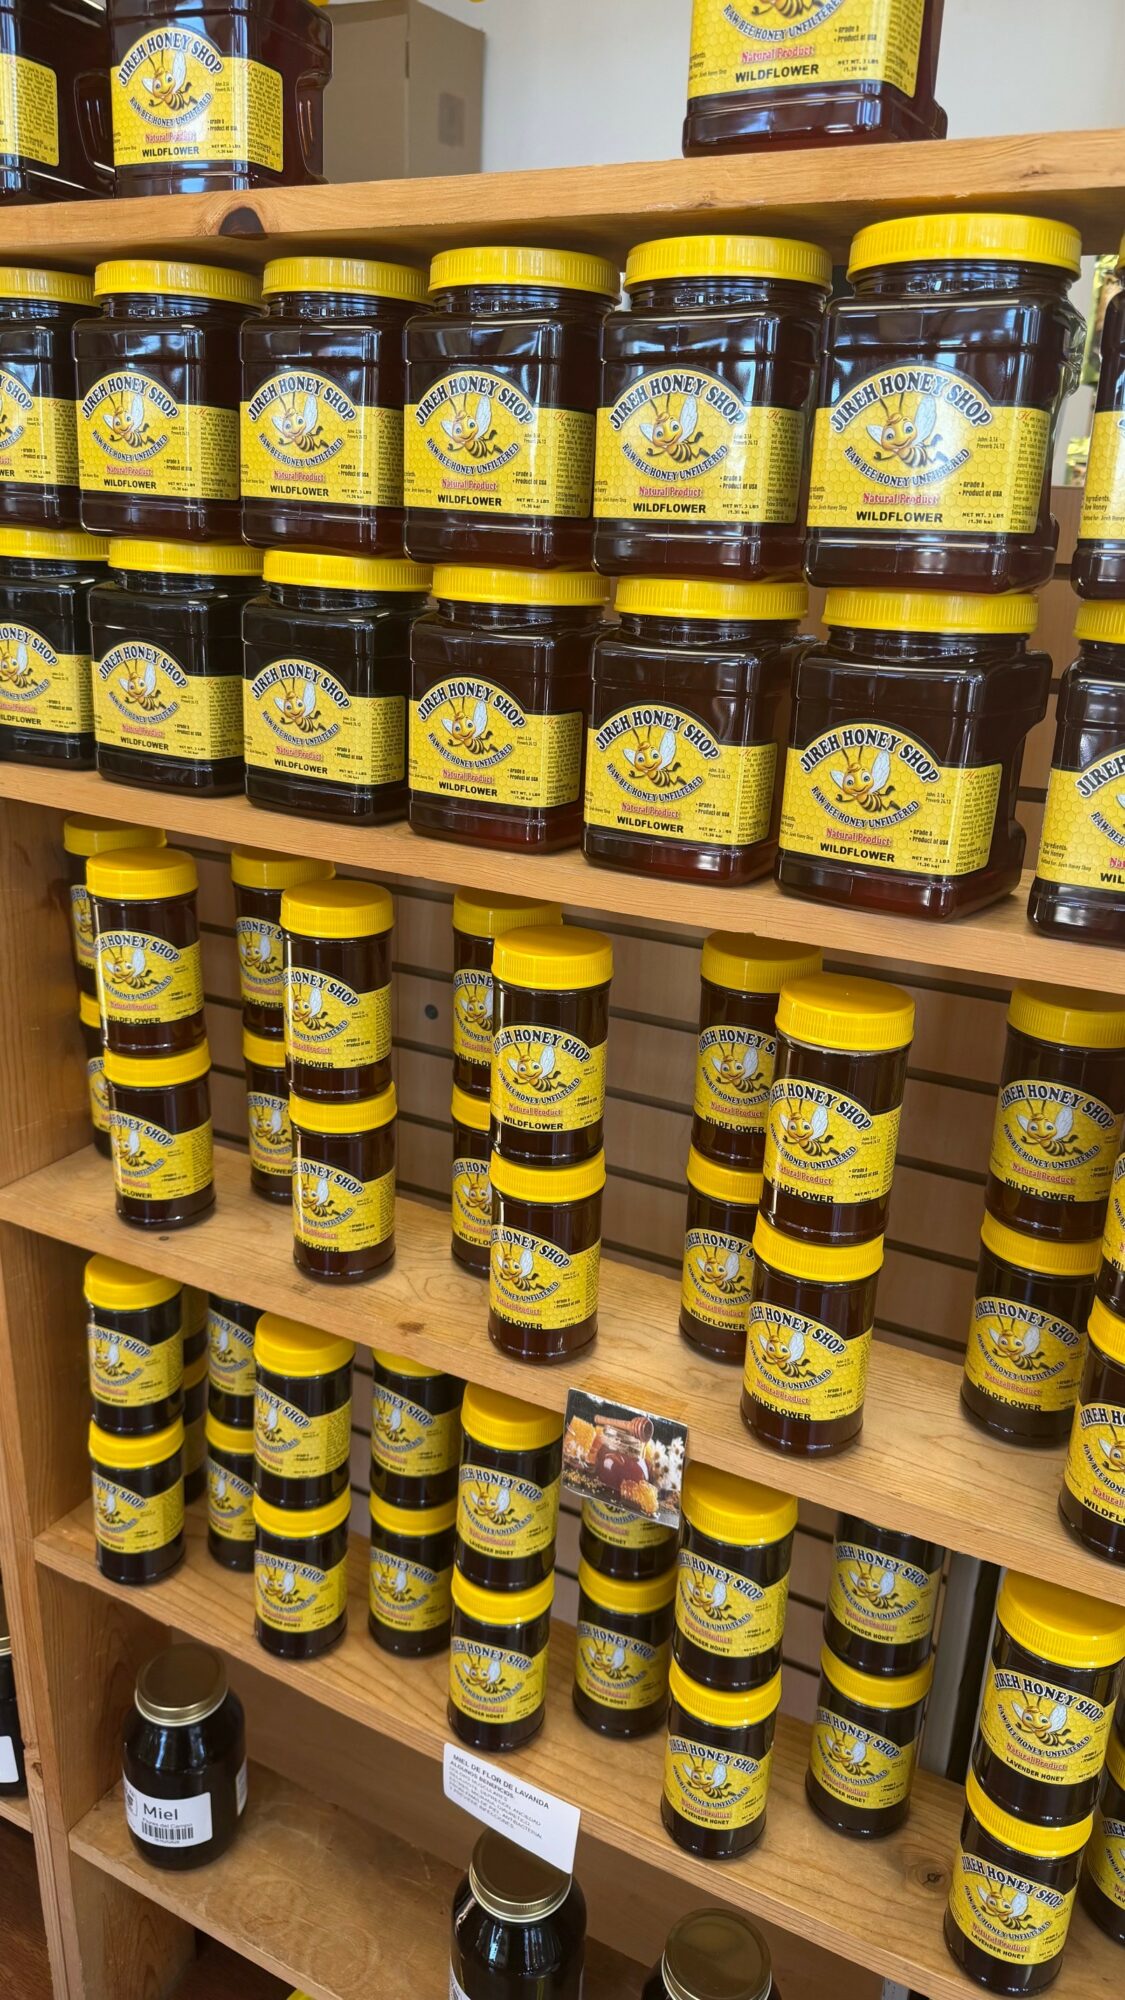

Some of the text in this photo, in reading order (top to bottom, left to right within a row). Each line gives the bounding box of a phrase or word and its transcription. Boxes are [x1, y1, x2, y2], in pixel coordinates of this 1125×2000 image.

[723, 5, 785, 41] RAW BEE HONEY
[119, 31, 223, 86] JIREH HONEY SHOP
[735, 64, 819, 83] WILDFLOWER
[142, 146, 200, 157] WILDFLOWER
[6, 380, 33, 410] SHOP
[81, 375, 179, 419] JIREH HONEY SHOP
[249, 375, 357, 421] JIREH HONEY SHOP
[416, 375, 534, 426] JIREH HONEY SHOP
[609, 374, 746, 430] JIREH HONEY SHOP
[831, 371, 992, 432] JIREH HONEY SHOP
[844, 446, 862, 472] RAW
[861, 463, 876, 482] BEE
[877, 472, 910, 487] HONEY
[103, 479, 157, 490] WILDFLOWER
[270, 485, 329, 497] WILDFLOWER
[863, 492, 897, 504] Natural
[437, 493, 502, 507] WILDFLOWER
[632, 502, 706, 514] WILDFLOWER
[856, 510, 943, 523] WILDFLOWER
[31, 635, 59, 666] SHOP
[99, 645, 187, 688] JIREH HONEY SHOP
[251, 663, 351, 710] JIREH HONEY SHOP
[418, 681, 526, 729] JIREH HONEY SHOP
[120, 735, 169, 751] WILDFLOWER
[595, 709, 720, 761] JIREH HONEY SHOP
[274, 756, 328, 776] WILDFLOWER
[800, 729, 940, 783] JIREH HONEY SHOP
[438, 781, 498, 797] WILDFLOWER
[1076, 755, 1125, 797] JIREH
[810, 787, 919, 828] RAW BEE HONEY UNFILTERED
[616, 815, 684, 834] WILDFLOWER
[826, 828, 891, 846] Natural Product
[819, 841, 895, 863] WILDFLOWER
[241, 920, 275, 938] HONEY
[106, 934, 181, 963] HONEY SHOP
[290, 970, 360, 1007] HONEY SHOP
[515, 1030, 561, 1045] HONEY
[561, 1036, 591, 1063] SHOP
[719, 1029, 765, 1049] HONEY
[788, 1084, 872, 1130] HONEY SHOP
[1001, 1084, 1115, 1130] JIREH HONEY SHOP
[142, 1123, 175, 1147] SHOP
[503, 1115, 563, 1130] WILDFLOWER
[706, 1115, 766, 1134] WILDFLOWER
[1052, 1145, 1100, 1169] UNFILTERED
[332, 1171, 364, 1196] SHOP
[1005, 1176, 1076, 1202] WILDFLOWER
[501, 1229, 570, 1268] HONEY SHOP
[704, 1234, 747, 1256] HONEY
[690, 1308, 745, 1330] WILDFLOWER
[765, 1306, 846, 1355] HONEY SHOP
[975, 1301, 1080, 1347] JIREH HONEY SHOP
[123, 1339, 152, 1358] SHOP
[751, 1392, 812, 1422] WILDFLOWER
[977, 1382, 1042, 1412] WILDFLOWER
[282, 1406, 311, 1429] SHOP
[406, 1404, 435, 1427] SHOP
[1080, 1408, 1109, 1428] JIREH
[120, 1490, 146, 1509] SHOP
[475, 1470, 544, 1502] HONEY SHOP
[299, 1566, 327, 1585] SHOP
[692, 1558, 764, 1602] HONEY SHOP
[858, 1549, 930, 1588] HONEY SHOP
[466, 1643, 533, 1671] HONEY SHOP
[994, 1673, 1105, 1723] JIREH HONEY SHOP
[832, 1717, 901, 1759] HONEY SHOP
[689, 1744, 759, 1775] HONEY SHOP
[1006, 1756, 1065, 1782] LAVENDER HONEY
[453, 1754, 550, 1810] MIEL DE FLOR DE LAVANDA
[143, 1802, 178, 1821] Miel
[962, 1856, 1064, 1909] JIREH HONEY SHOP
[971, 1932, 1025, 1960] LAVENDER HONEY
